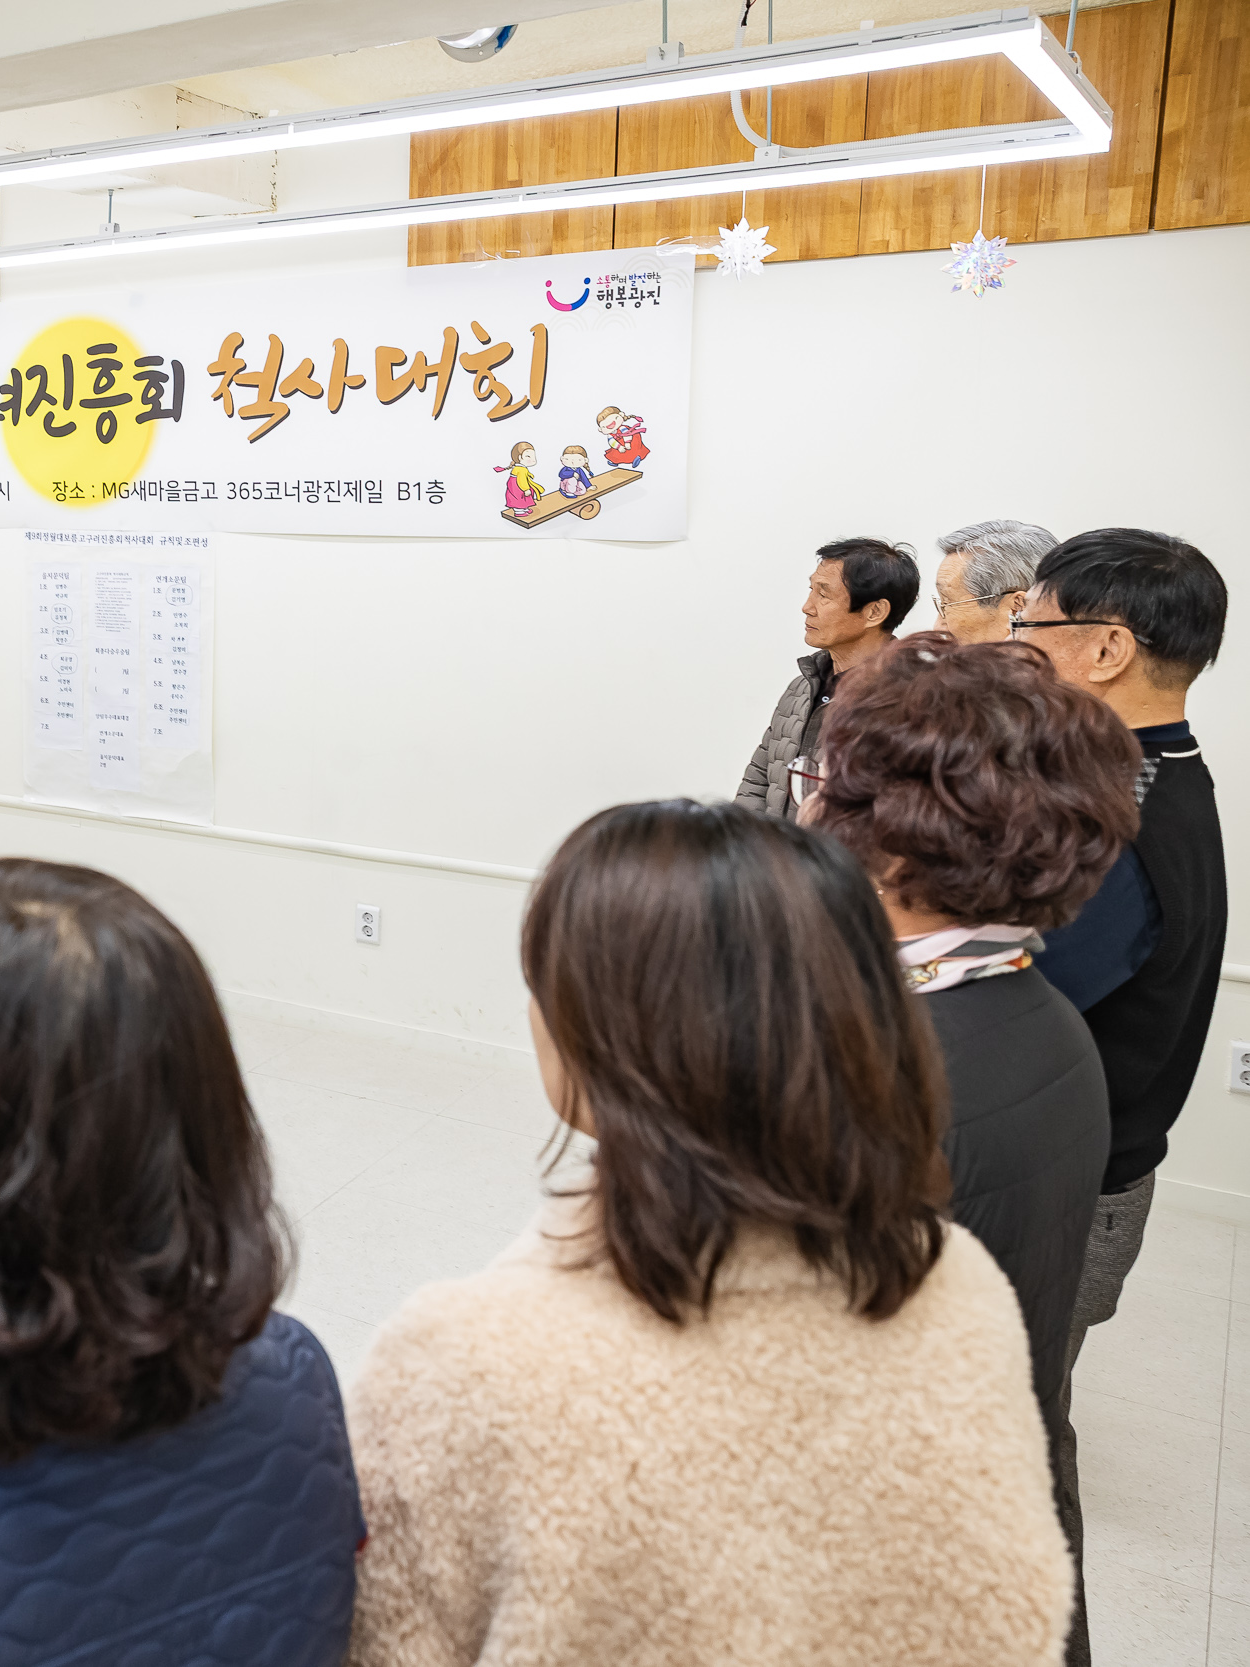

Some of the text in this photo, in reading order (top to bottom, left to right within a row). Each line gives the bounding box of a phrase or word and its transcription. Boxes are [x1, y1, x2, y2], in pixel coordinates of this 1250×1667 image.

[596, 271, 662, 289] 소통하며 발전하는
[596, 285, 661, 310] 행복광진
[207, 319, 550, 444] 척사대회
[52, 480, 87, 501] 장소
[101, 480, 219, 502] MG새마을금고
[226, 480, 384, 506] 365코너광진제일
[397, 482, 448, 506] B1층
[42, 572, 70, 580] 을지문덕팀
[155, 575, 187, 583] 연개소문팀
[152, 610, 162, 618] 2조
[152, 633, 162, 641] 3조
